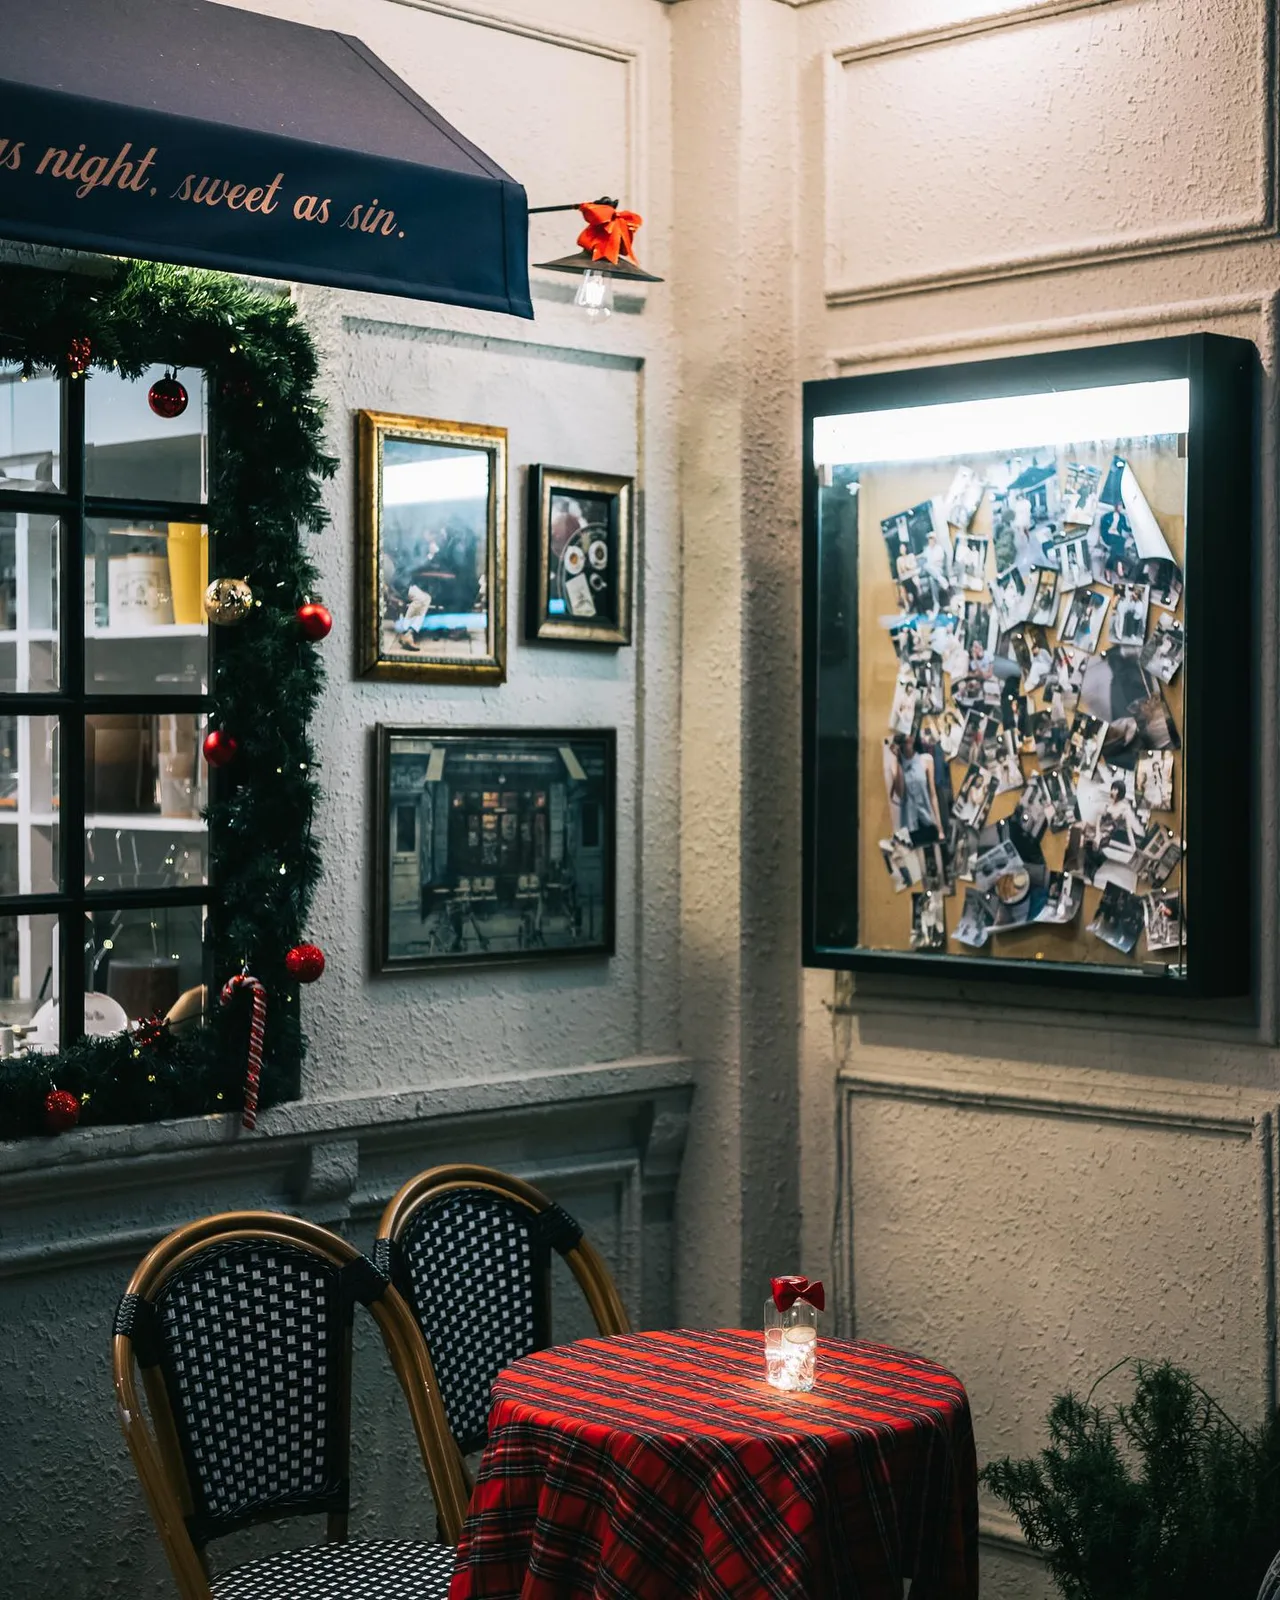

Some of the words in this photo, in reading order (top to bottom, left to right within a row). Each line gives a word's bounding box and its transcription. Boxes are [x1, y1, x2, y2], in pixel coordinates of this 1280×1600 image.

[35, 142, 158, 199] night,
[169, 173, 285, 214] sweet
[293, 194, 332, 224] as
[340, 198, 405, 238] sin.
